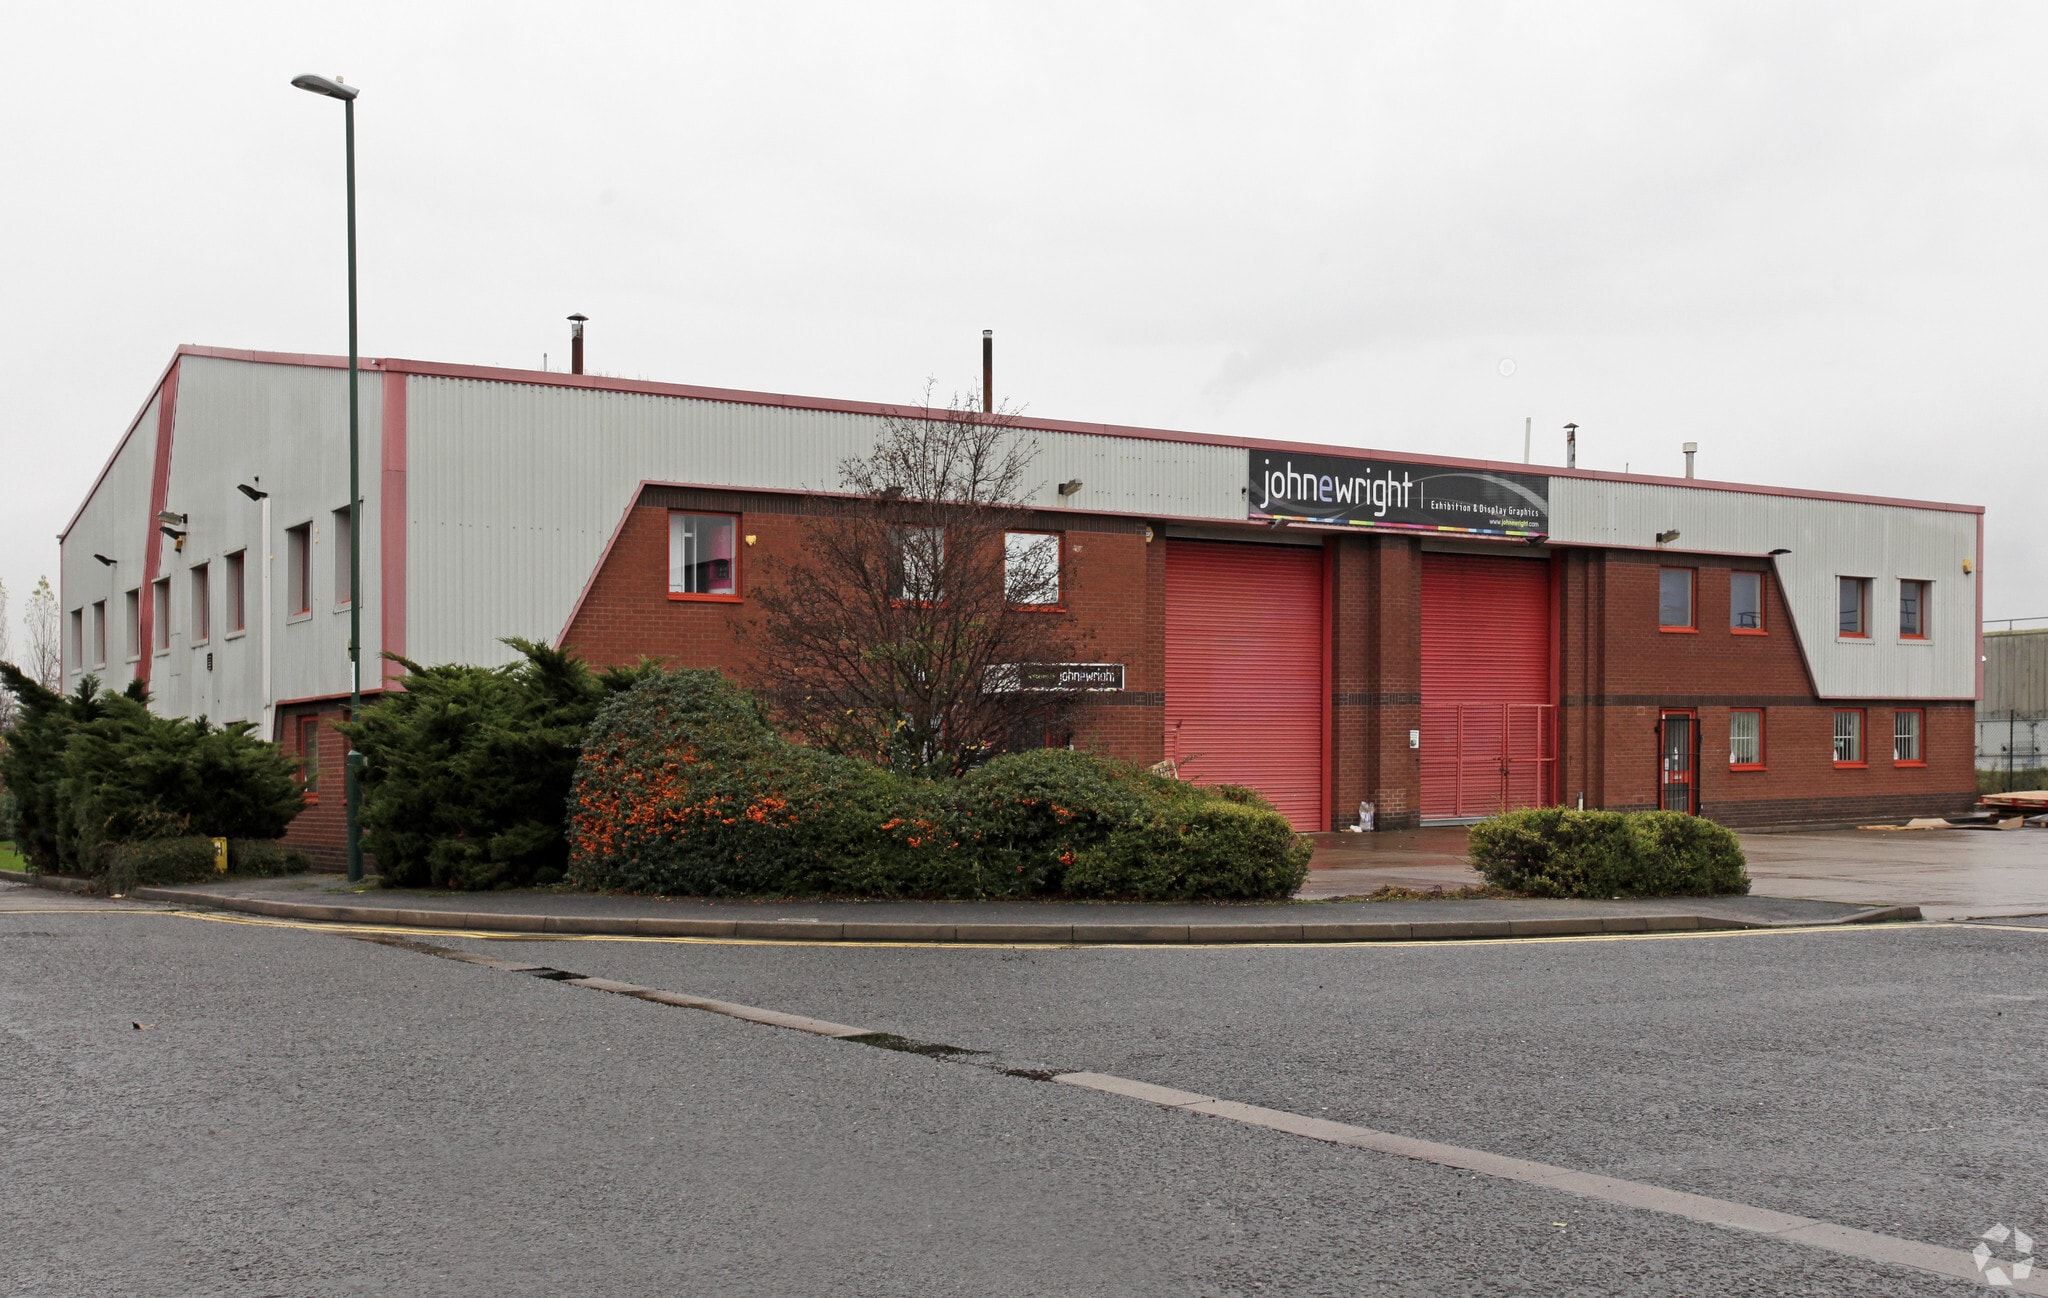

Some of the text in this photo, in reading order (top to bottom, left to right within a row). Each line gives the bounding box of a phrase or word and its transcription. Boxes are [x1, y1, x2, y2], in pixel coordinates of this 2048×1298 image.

[1260, 459, 1413, 517] johnewright
[1431, 500, 1539, 518] Exhibition & Display Graphics
[1489, 519, 1539, 528] www.johnewright.com
